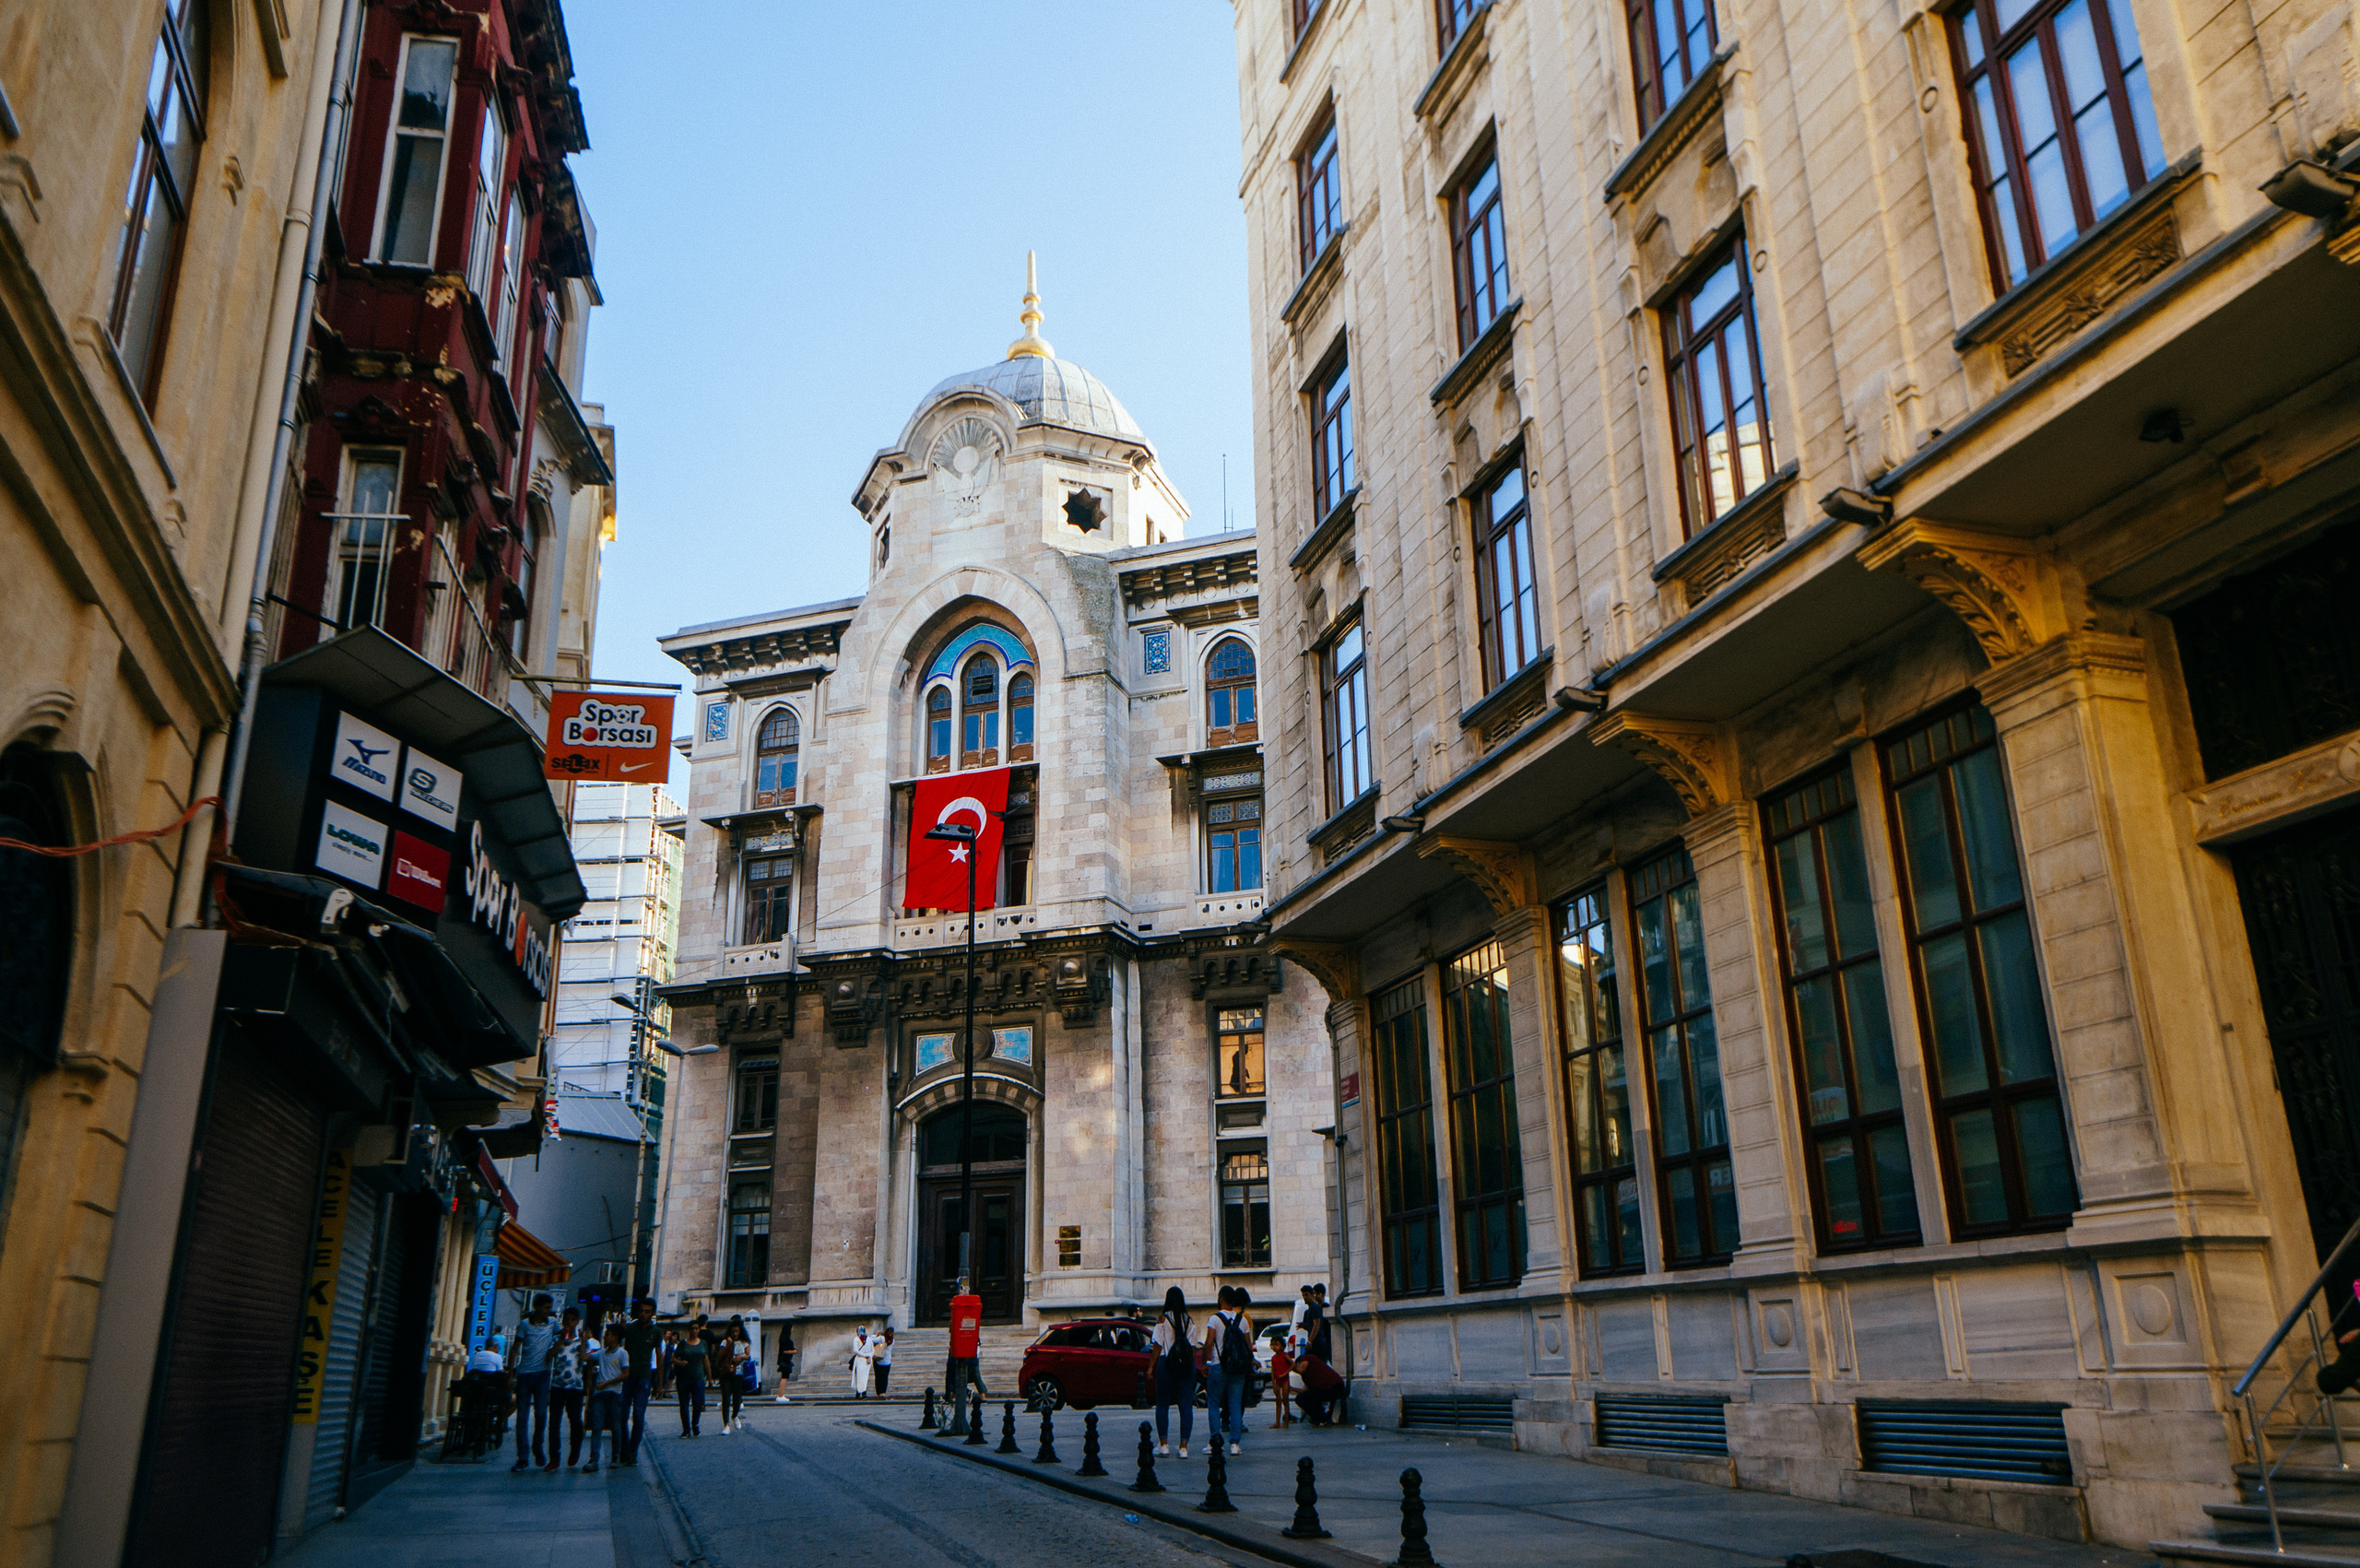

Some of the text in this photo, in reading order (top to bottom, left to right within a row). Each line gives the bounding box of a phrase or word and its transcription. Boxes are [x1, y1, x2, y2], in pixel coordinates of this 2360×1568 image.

[584, 703, 640, 725] Spor
[569, 722, 651, 743] Borsası
[326, 823, 380, 855] LOWA
[475, 1262, 494, 1337] ÜÇLER
[292, 1279, 330, 1415] KAŞE
